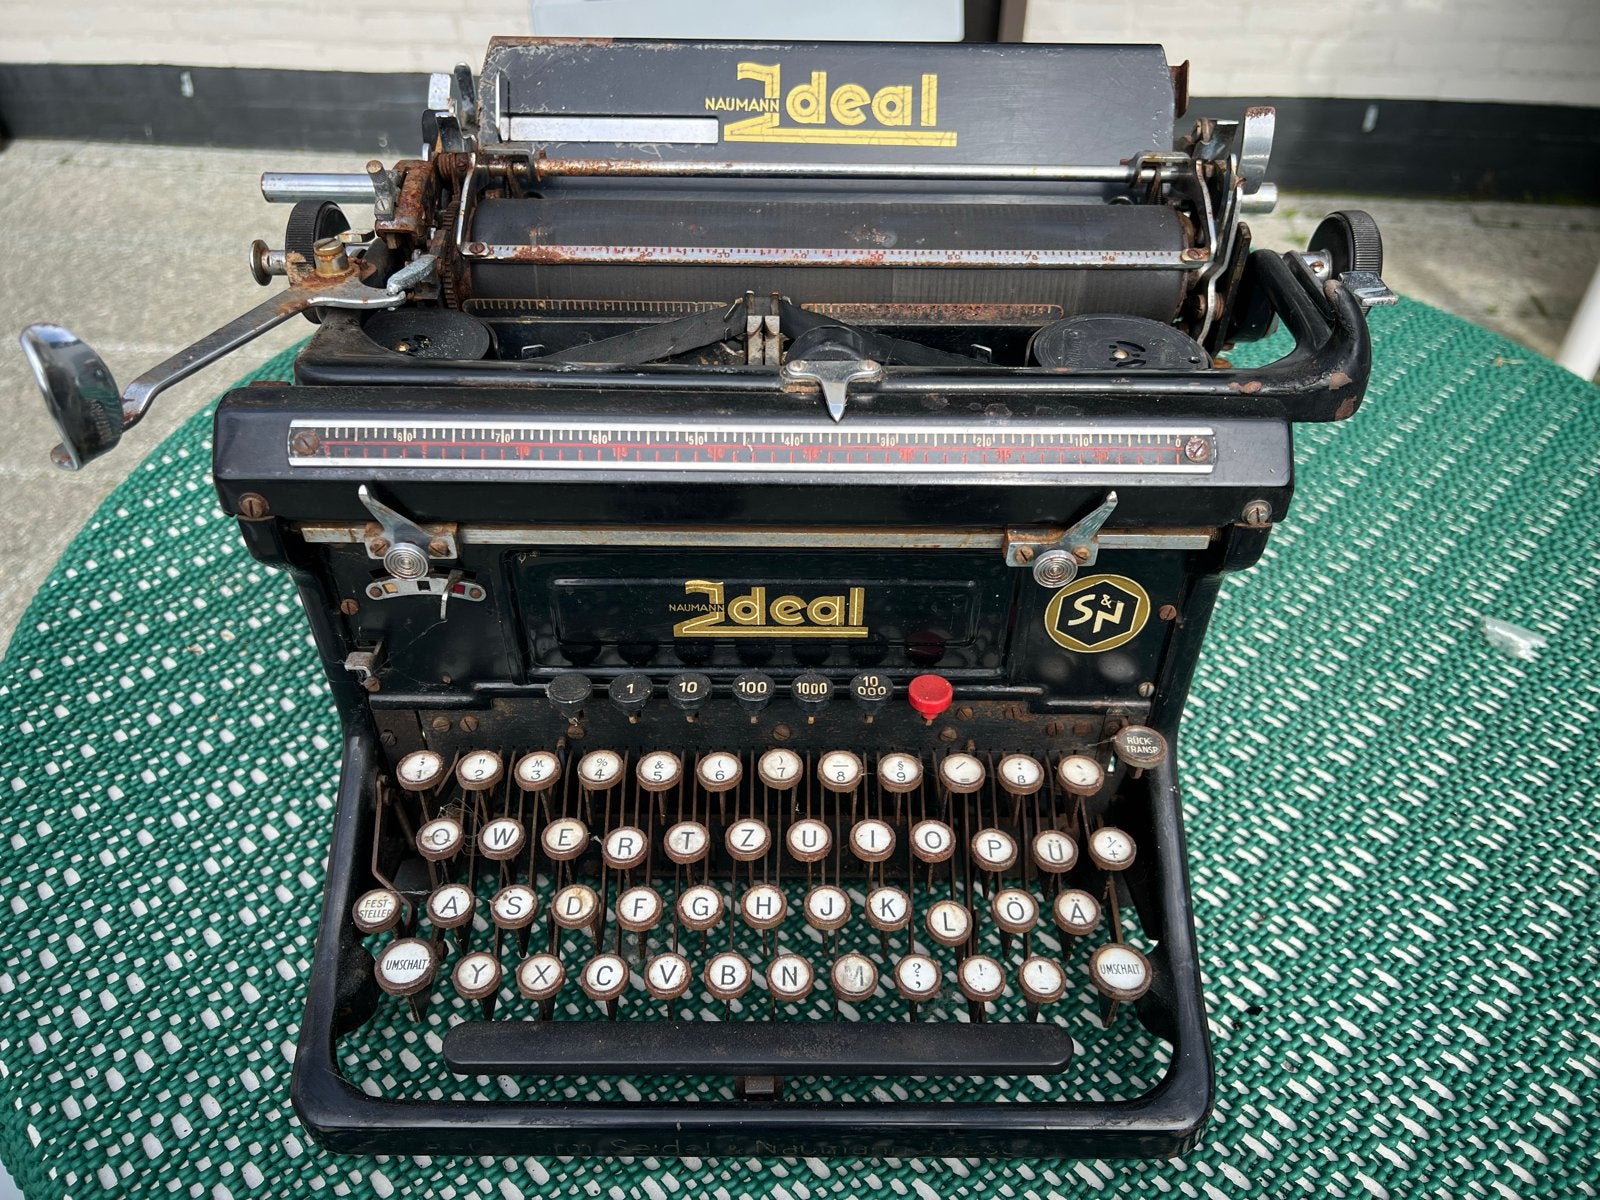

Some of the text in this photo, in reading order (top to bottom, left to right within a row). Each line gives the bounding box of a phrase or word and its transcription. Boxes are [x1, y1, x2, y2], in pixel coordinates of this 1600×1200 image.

[704, 97, 780, 113] NAUMANN
[397, 432, 413, 442] 80
[495, 433, 511, 443] 70
[592, 435, 608, 444] 60
[688, 436, 704, 446] 50
[784, 436, 800, 446] 40
[880, 437, 896, 447] 30
[976, 437, 992, 447] 20
[1175, 438, 1181, 447] 0
[669, 603, 725, 613] NAUMANN
[626, 683, 635, 694] 1
[679, 681, 699, 694] 10
[738, 681, 767, 694] 100
[796, 682, 828, 695] 1000
[862, 675, 879, 687] 10
[1126, 735, 1153, 745] RÜCK-
[596, 758, 609, 767] %
[654, 761, 665, 770] &
[897, 760, 904, 771] §
[474, 769, 485, 780] 2
[530, 770, 542, 780] 3
[594, 769, 606, 779] 4
[653, 771, 663, 781] 5
[715, 770, 726, 780] 6
[776, 767, 787, 778] 7
[836, 771, 847, 781] 8
[896, 771, 906, 782] 9
[431, 828, 451, 846] Q
[493, 827, 516, 846] W
[558, 828, 574, 847] E
[681, 831, 695, 850] T
[740, 829, 755, 847] Z
[802, 830, 817, 848] U
[924, 831, 942, 849] O
[617, 837, 633, 856] R
[987, 839, 1003, 858] P
[1047, 839, 1064, 862] Ü
[365, 899, 393, 908] FEST-
[440, 895, 458, 916] A
[505, 896, 523, 916] S
[565, 896, 583, 916] D
[633, 898, 647, 917] F
[692, 897, 709, 917] G
[755, 896, 772, 916] H
[820, 897, 833, 916] J
[881, 897, 896, 918] K
[1006, 897, 1025, 921] Ö
[1070, 898, 1088, 923] Ä
[942, 911, 956, 931] L
[470, 963, 488, 985] Y
[531, 964, 551, 985] X
[596, 965, 614, 986] C
[659, 964, 678, 985] V
[720, 964, 736, 985] B
[782, 965, 798, 987] N
[912, 963, 922, 977] ?
[978, 963, 984, 976] !
